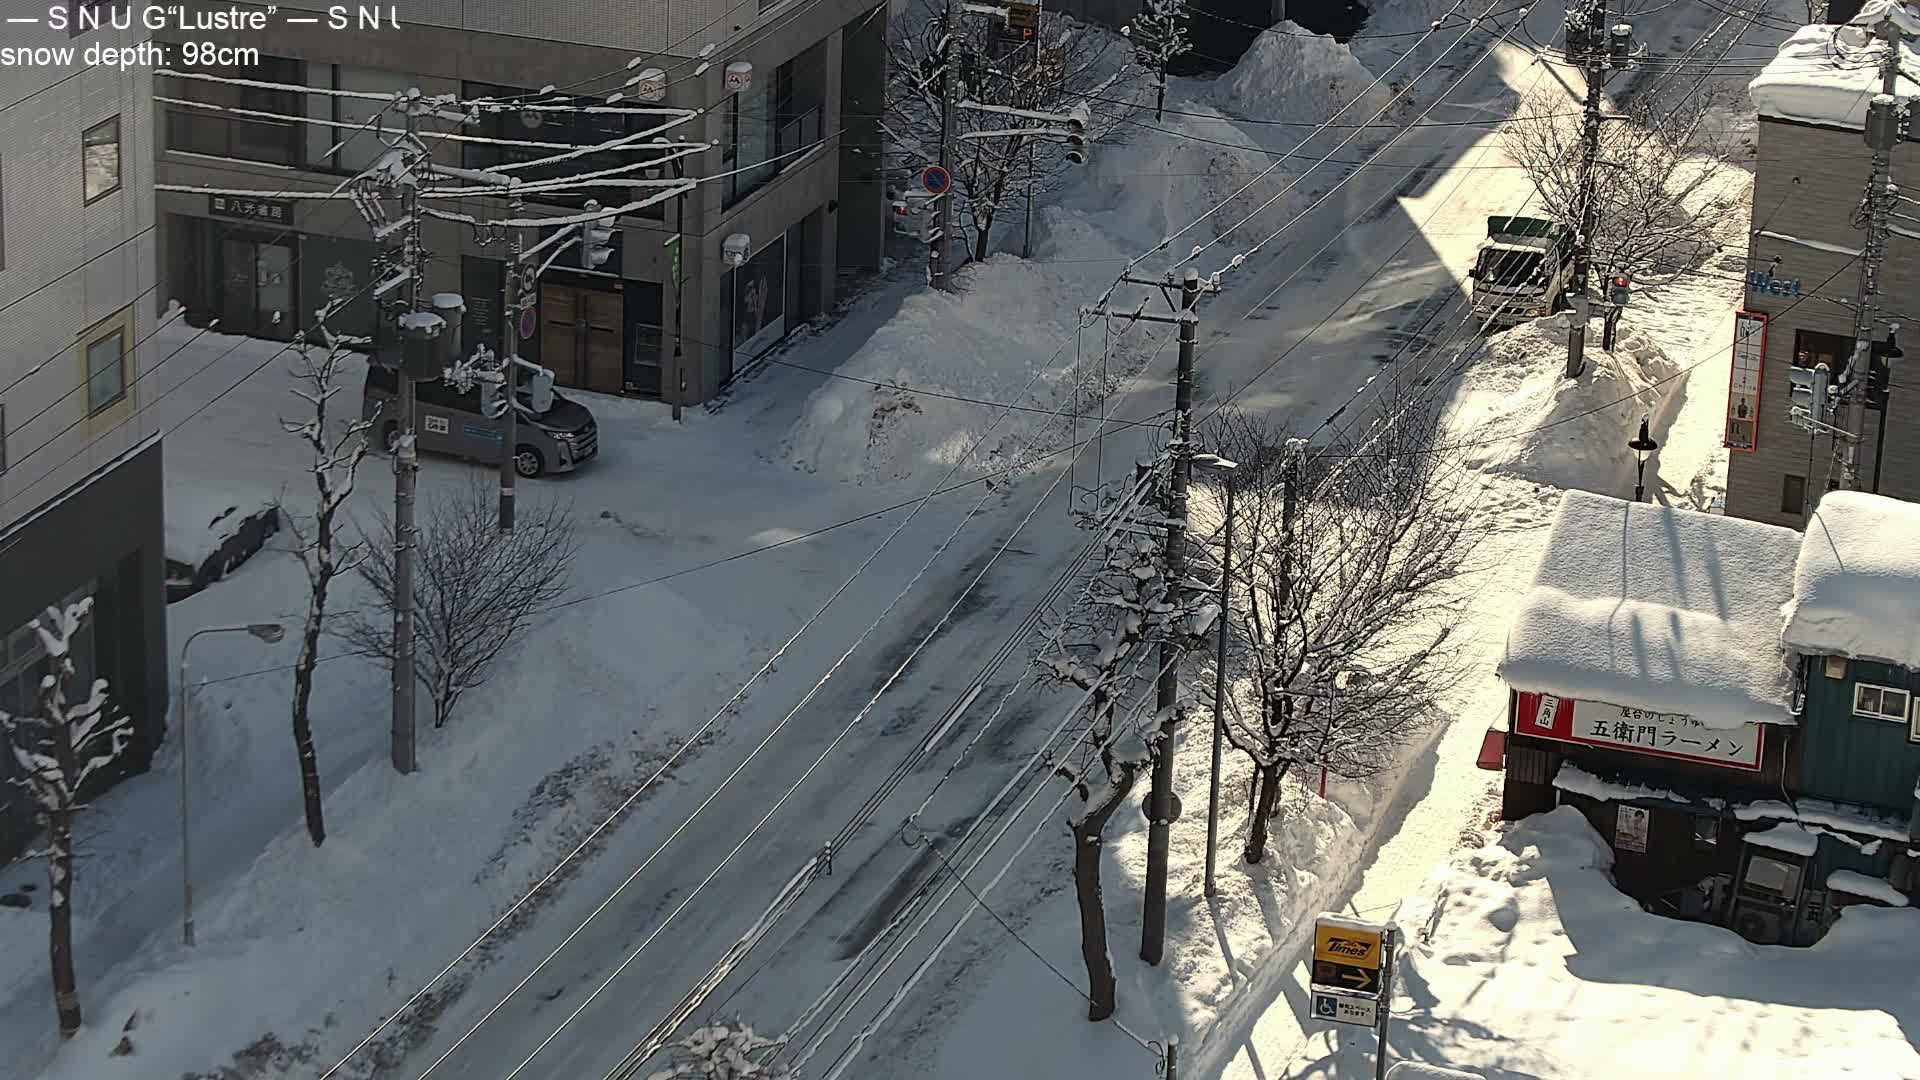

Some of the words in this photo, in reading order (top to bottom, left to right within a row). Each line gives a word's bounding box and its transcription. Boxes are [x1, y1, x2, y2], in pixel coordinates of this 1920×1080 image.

[1537, 698, 1555, 727] 三角山
[1590, 719, 1744, 757] 五衛門ラーメン
[1327, 937, 1372, 956] Times
